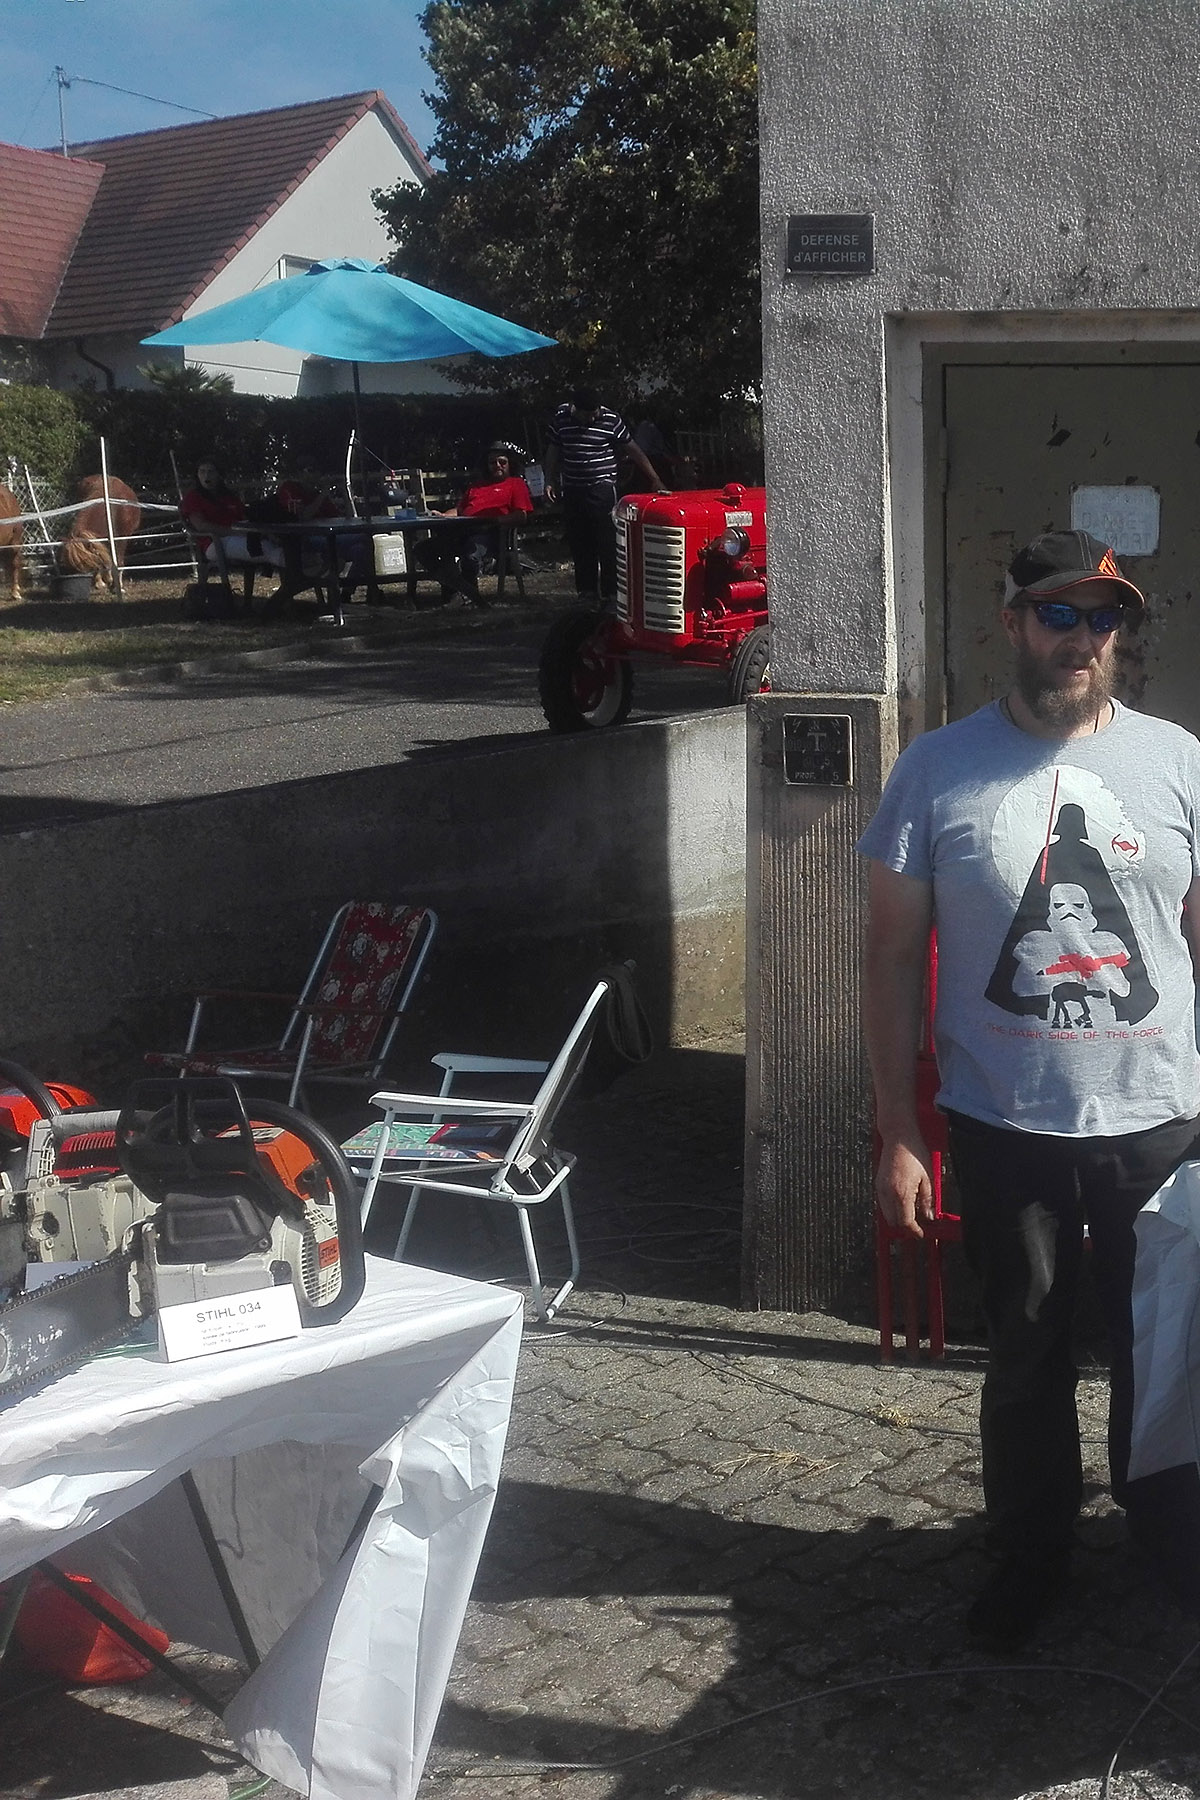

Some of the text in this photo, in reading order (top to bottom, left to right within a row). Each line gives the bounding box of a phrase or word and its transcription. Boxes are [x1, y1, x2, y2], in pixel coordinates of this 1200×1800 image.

[801, 234, 860, 246] DEFENSE
[793, 251, 866, 263] d'AFFICHER
[985, 1022, 1164, 1040] THE DARK SIDE OF THE FORCE
[196, 1301, 262, 1323] STIHL 034
